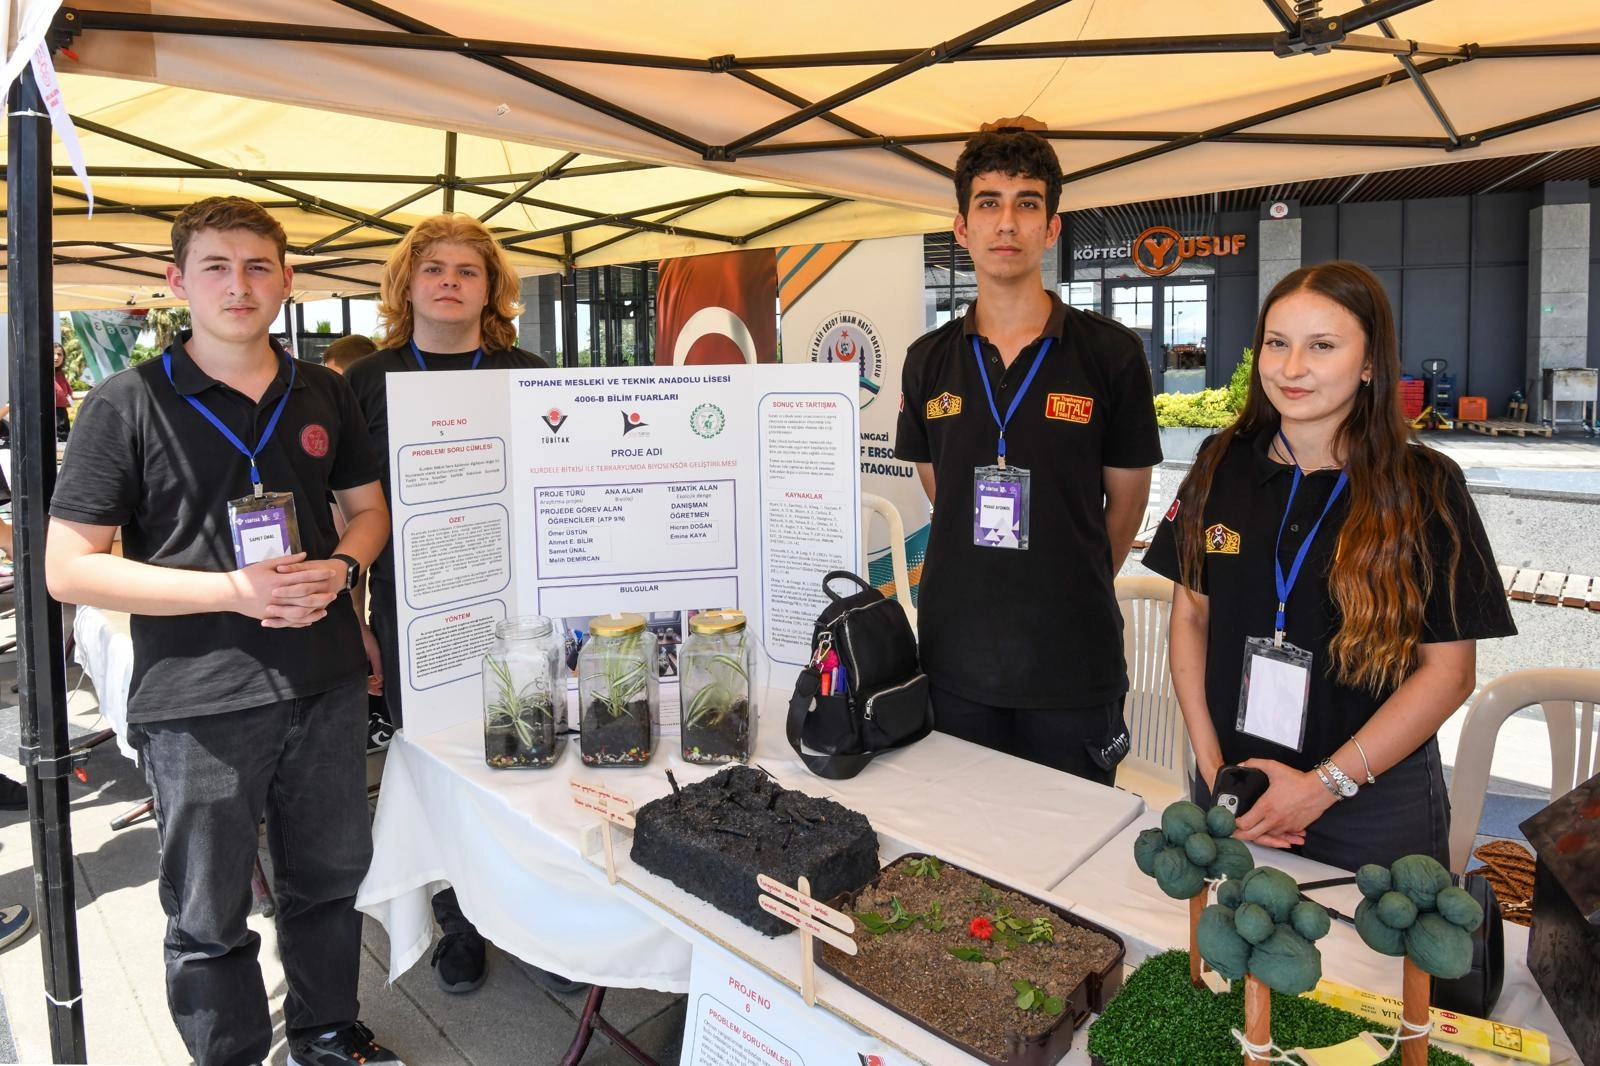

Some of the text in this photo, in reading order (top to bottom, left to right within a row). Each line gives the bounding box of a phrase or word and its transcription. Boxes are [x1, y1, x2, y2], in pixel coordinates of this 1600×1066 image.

[1074, 234, 1246, 270] KÖFTECİ YUSUF
[823, 318, 838, 335] ERSOY
[839, 313, 856, 324] İMAM
[857, 319, 873, 335] HATİP
[870, 335, 882, 378] ORTAOKULU
[565, 378, 605, 386] MESLEKİ
[622, 376, 655, 385] TEKNİK
[607, 394, 632, 402] BİLİM
[612, 449, 643, 457] PROJE
[785, 492, 822, 500] KAYNAKLAR
[670, 511, 709, 519] ÖĞRETMEN
[548, 516, 595, 525] ÖĞRENCİLER
[445, 612, 471, 623] YÖNTEM
[728, 976, 771, 1010] PROJE NO
[745, 1003, 751, 1013] 6
[742, 1031, 760, 1048] SORU
